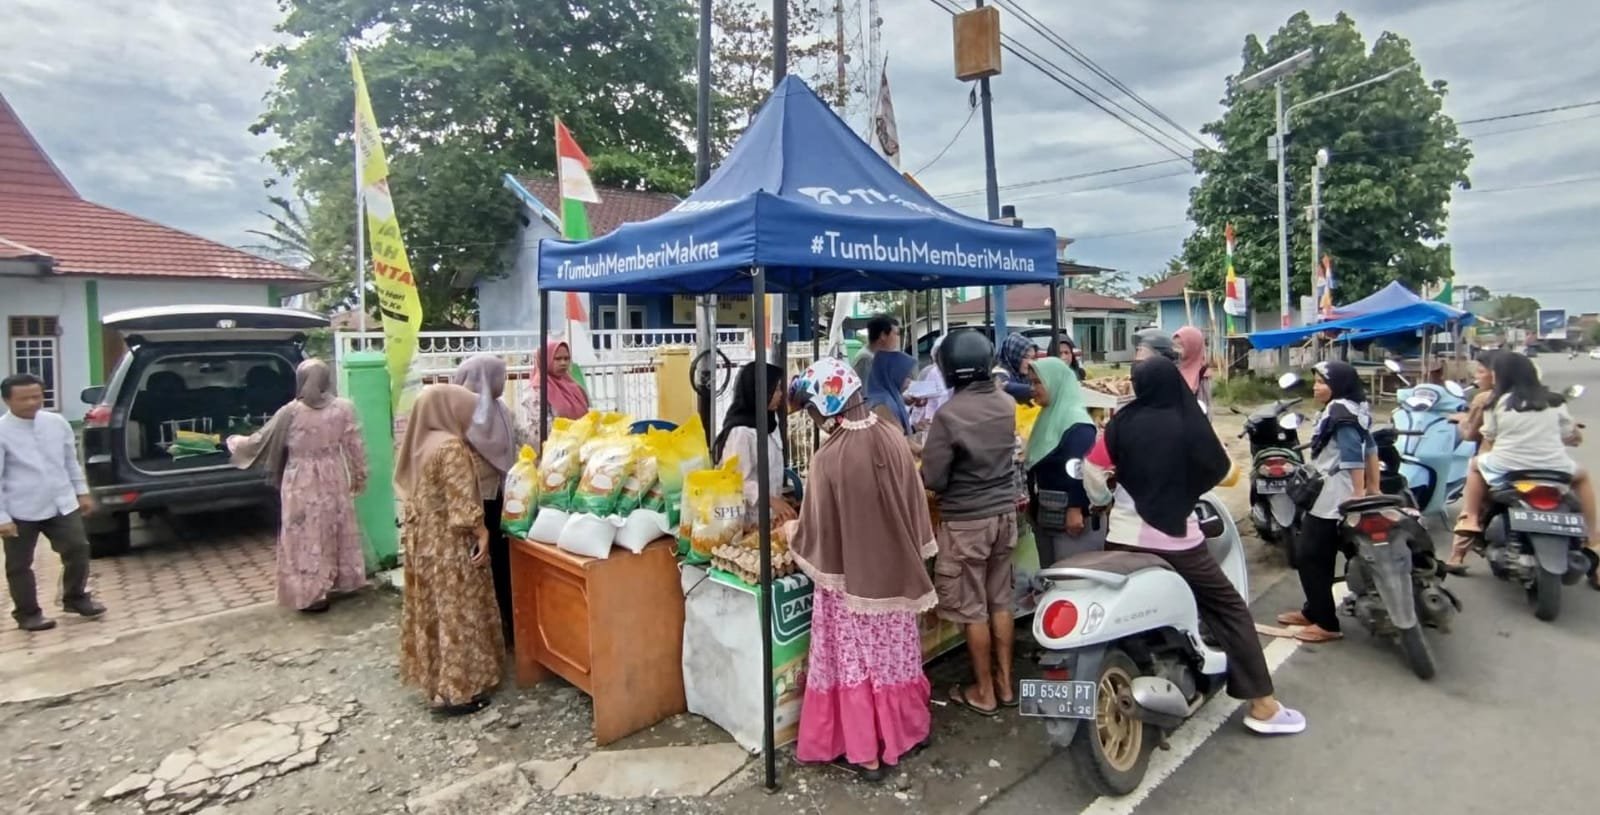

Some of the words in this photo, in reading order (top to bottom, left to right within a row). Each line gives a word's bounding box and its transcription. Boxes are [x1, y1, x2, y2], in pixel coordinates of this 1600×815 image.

[556, 236, 719, 281] #TumbuhMemberiMakna
[811, 231, 1035, 273] #TumbuhMemberiMakna
[375, 261, 415, 287] NTA
[1022, 683, 1036, 697] BD
[1040, 684, 1068, 699] 6549
[1075, 685, 1091, 700] PT
